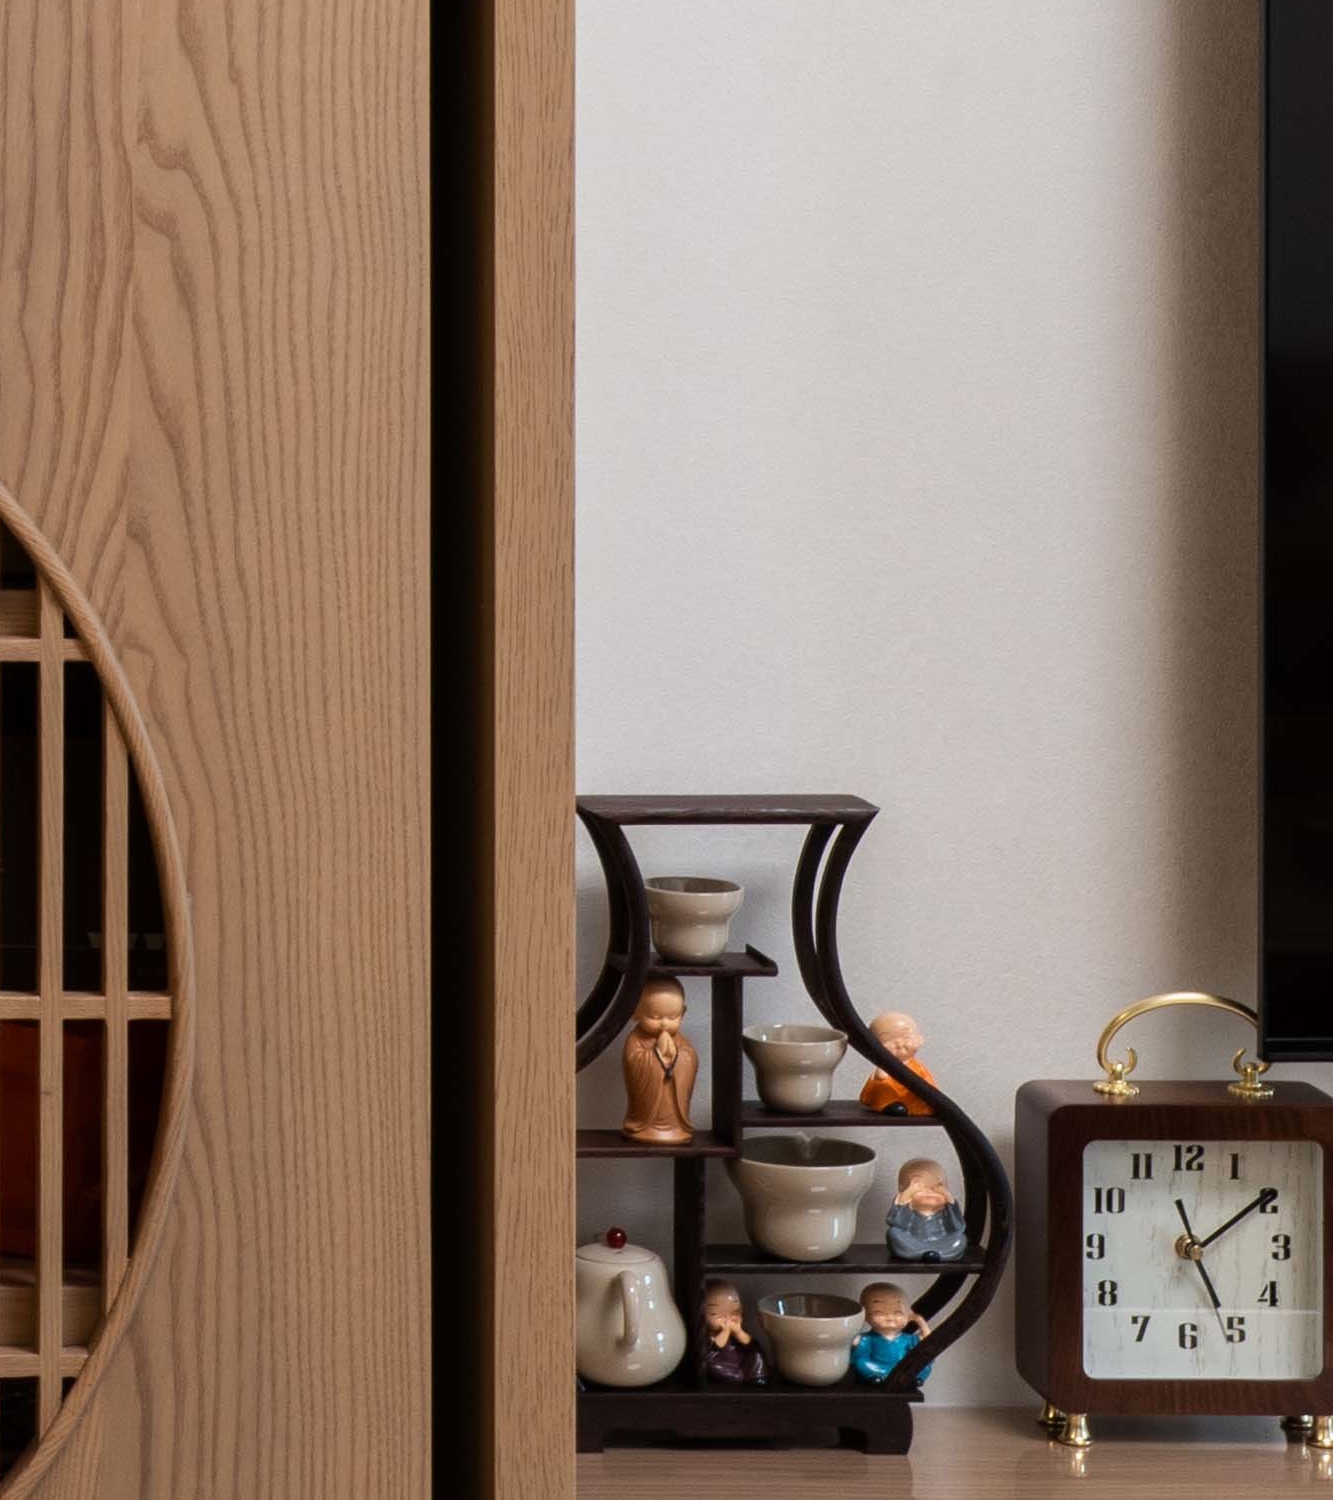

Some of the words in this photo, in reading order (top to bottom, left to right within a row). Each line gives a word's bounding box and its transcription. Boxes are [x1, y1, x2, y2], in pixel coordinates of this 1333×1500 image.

[1131, 1153, 1154, 1180] 11
[1173, 1144, 1205, 1171] 12
[1229, 1153, 1240, 1180] 1
[1093, 1187, 1126, 1214] 10
[1258, 1187, 1279, 1214] 2
[1086, 1233, 1106, 1260] 9
[1271, 1234, 1291, 1261] 3
[1098, 1279, 1118, 1307] 8
[1257, 1280, 1279, 1307] 4
[1131, 1315, 1151, 1342] 7
[1178, 1322, 1198, 1350] 6
[1226, 1316, 1246, 1343] 5
